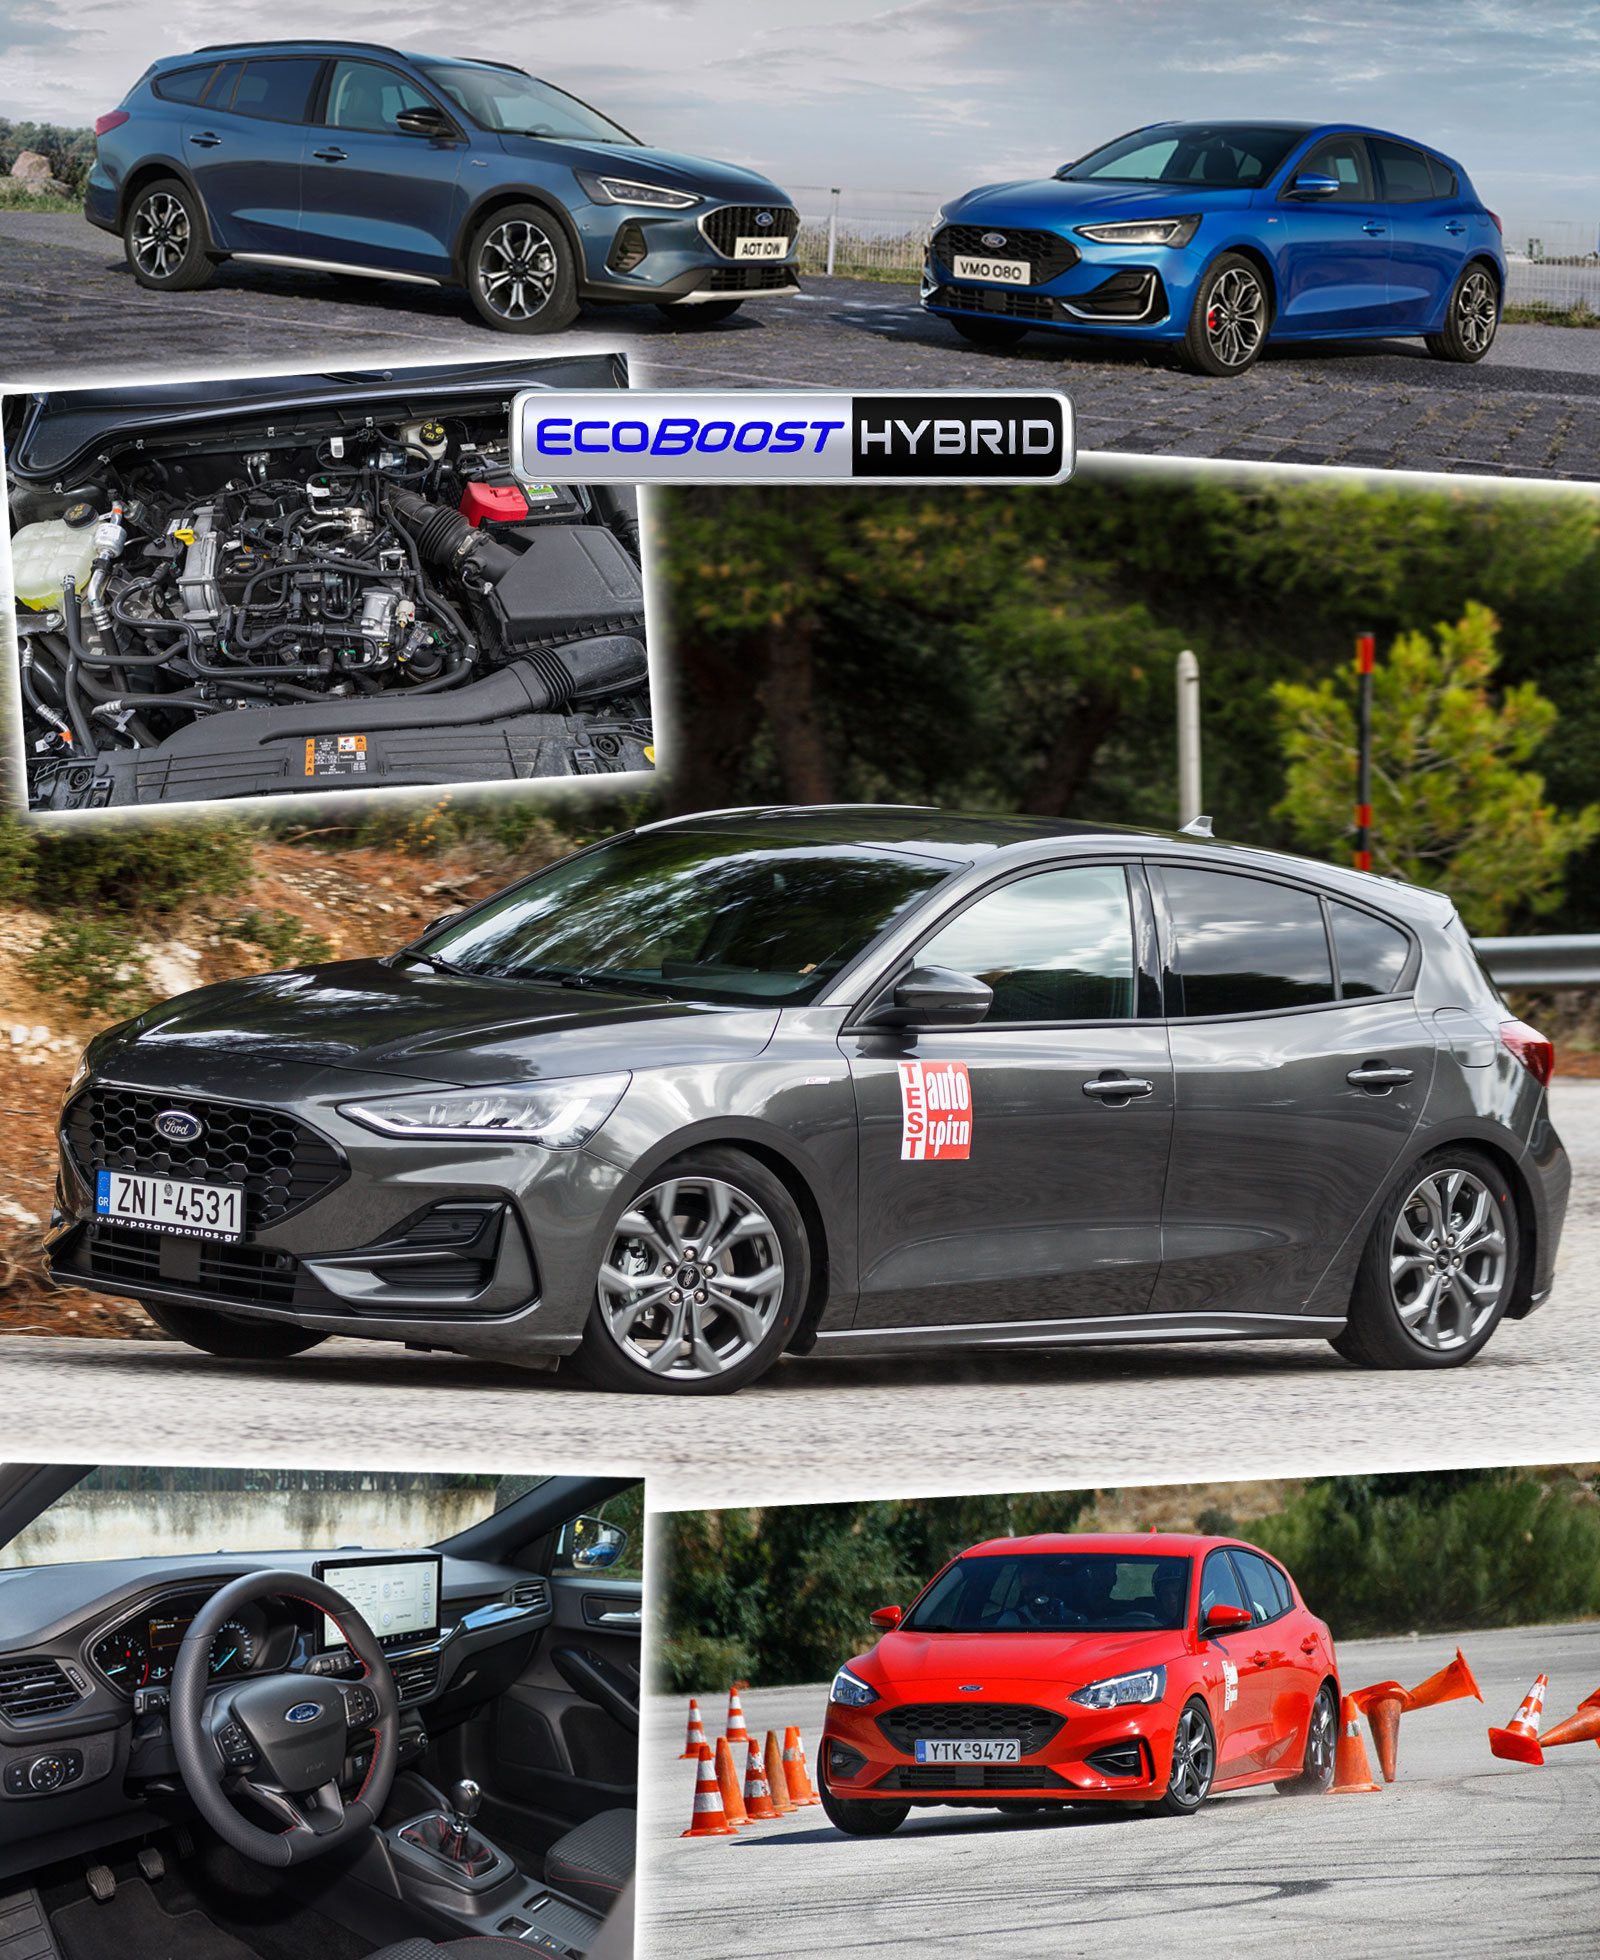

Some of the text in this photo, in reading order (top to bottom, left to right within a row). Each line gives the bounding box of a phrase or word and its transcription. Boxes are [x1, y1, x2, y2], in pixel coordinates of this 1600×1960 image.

[925, 1063, 969, 1111] auto
[900, 1063, 924, 1158] TEST
[163, 1116, 189, 1136] Ford
[98, 1196, 109, 1207] GR
[96, 1216, 239, 1243] www.pazaropoulos.gr
[930, 1743, 1016, 1761] YTK-9472
